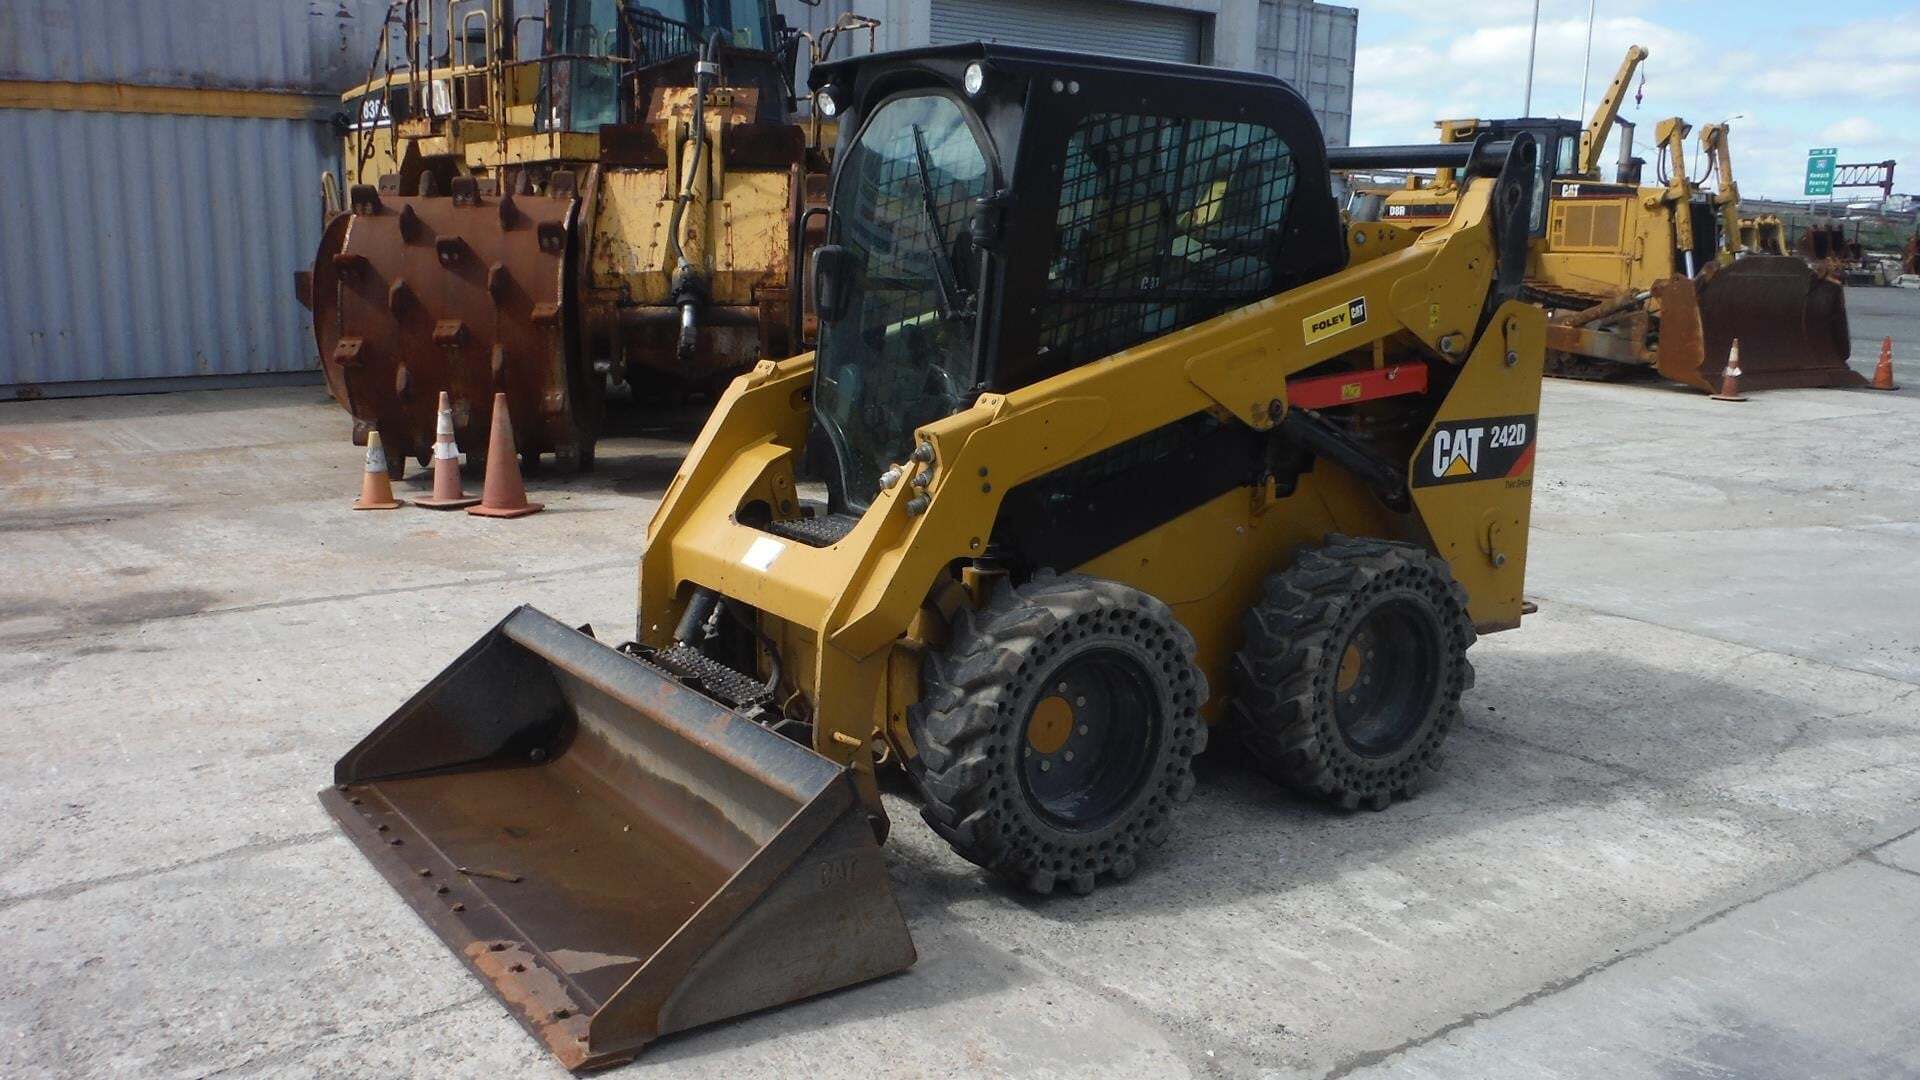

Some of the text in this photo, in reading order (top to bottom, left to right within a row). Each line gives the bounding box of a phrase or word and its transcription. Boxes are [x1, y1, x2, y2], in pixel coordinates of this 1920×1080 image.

[1561, 184, 1580, 197] CAT
[1311, 304, 1364, 333] FOLEY CAT
[1432, 423, 1527, 478] CAT 242D
